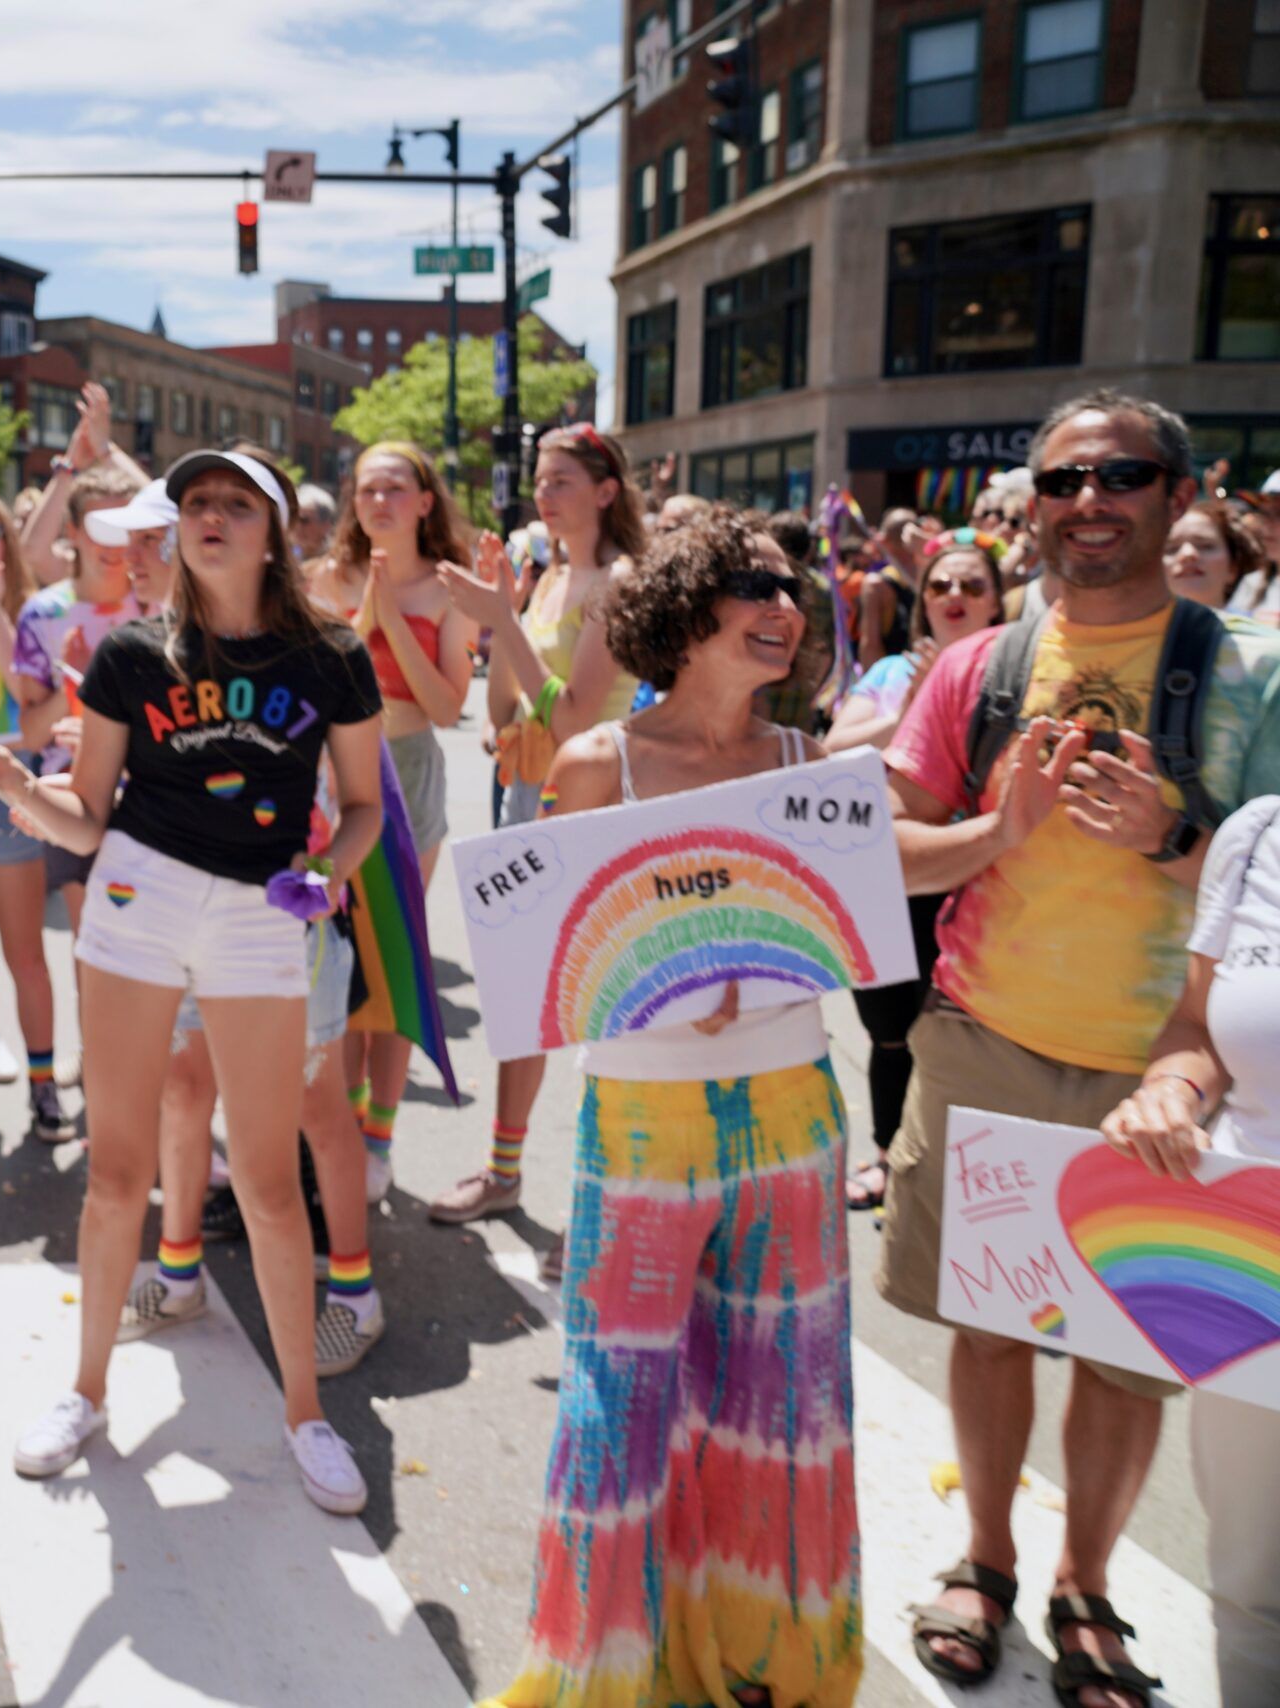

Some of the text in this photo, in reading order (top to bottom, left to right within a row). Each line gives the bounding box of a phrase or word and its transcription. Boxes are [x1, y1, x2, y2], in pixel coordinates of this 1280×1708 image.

[470, 250, 490, 269] St
[947, 429, 1035, 463] SALO
[143, 677, 318, 743] AERO 87
[784, 795, 872, 827] MOM
[474, 848, 545, 906] FREE
[653, 866, 732, 901] hugs
[948, 1127, 1037, 1201] FREE
[948, 1243, 1075, 1311] MOM
